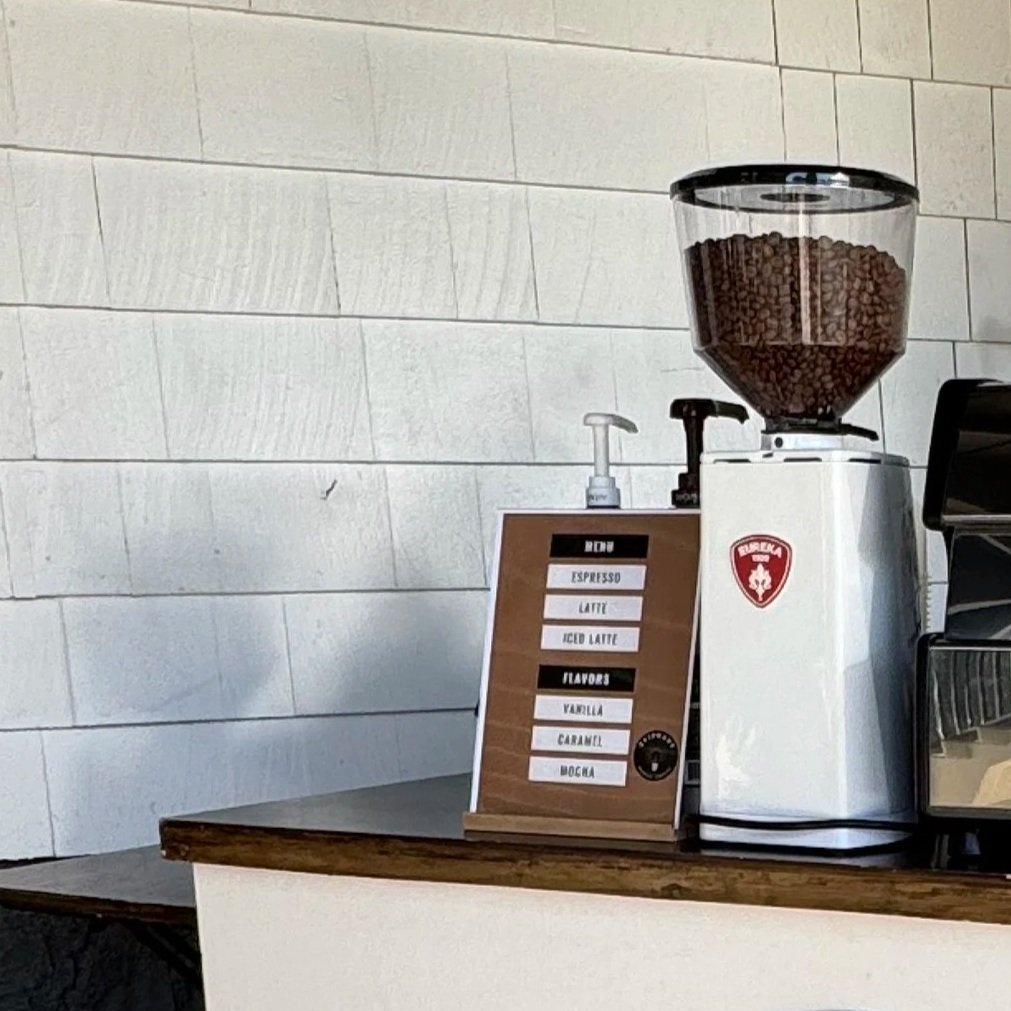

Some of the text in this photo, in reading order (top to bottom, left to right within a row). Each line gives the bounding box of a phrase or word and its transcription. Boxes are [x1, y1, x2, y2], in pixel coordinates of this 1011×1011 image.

[584, 540, 615, 553] MENU
[571, 571, 622, 584] ESPRESSO
[578, 601, 608, 615] LATTE
[562, 631, 618, 646] ICED LATTE
[562, 671, 611, 686] FLAVORS
[563, 703, 603, 717] VANILLA
[557, 734, 603, 748] CARAMEL
[560, 765, 596, 779] MOCHA
